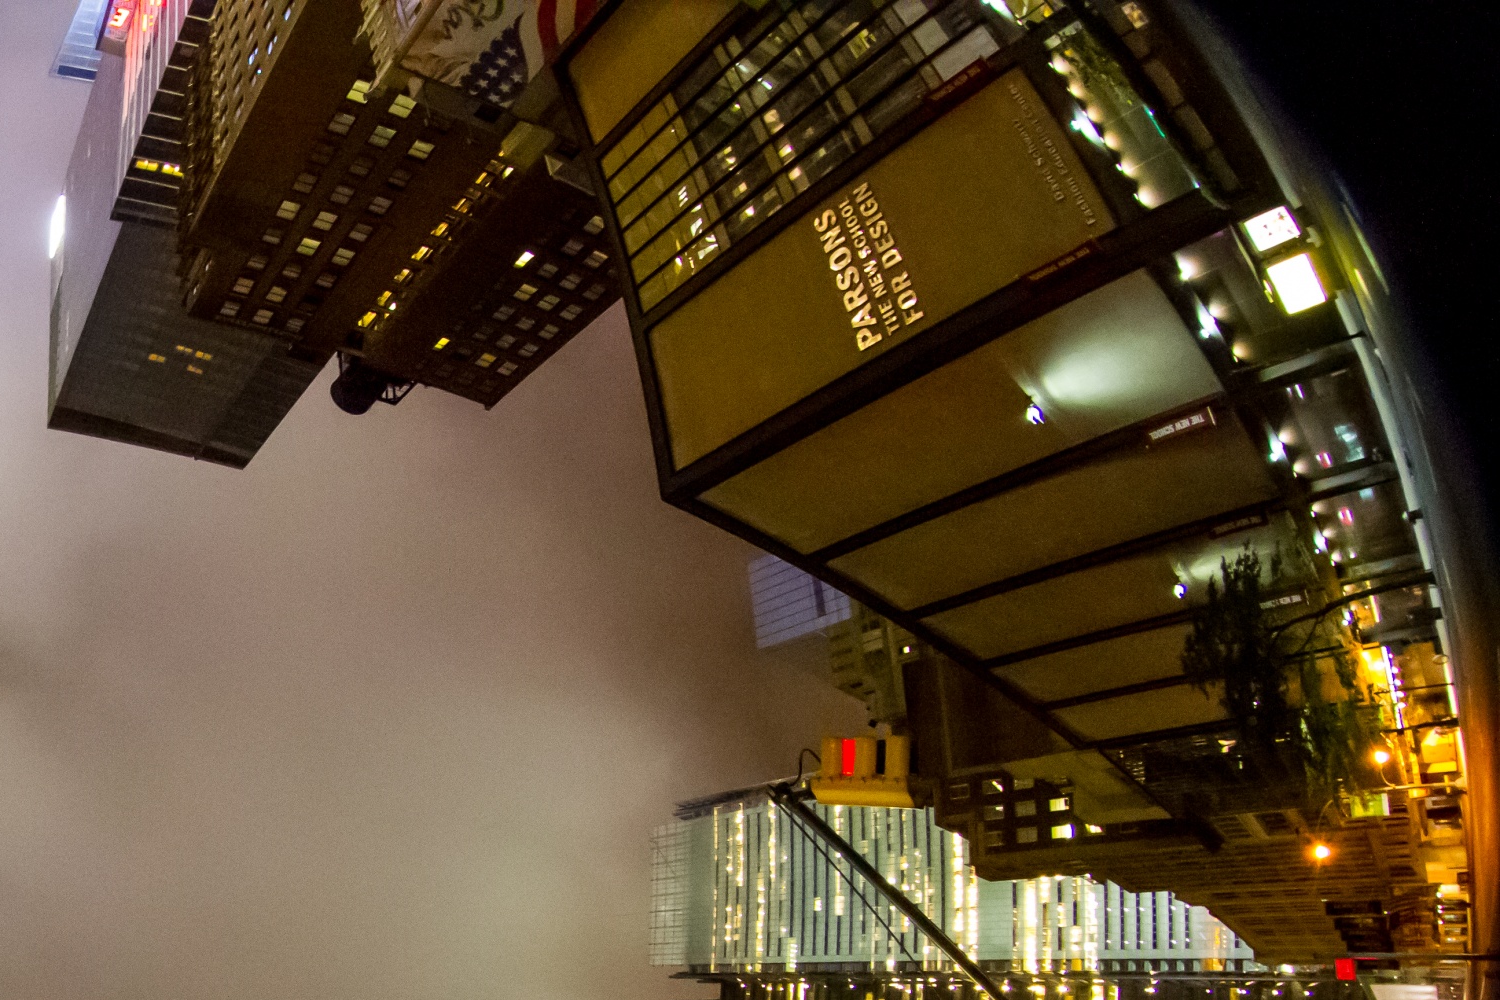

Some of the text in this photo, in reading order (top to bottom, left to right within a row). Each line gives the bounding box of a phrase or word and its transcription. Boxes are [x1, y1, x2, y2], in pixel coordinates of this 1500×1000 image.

[813, 208, 882, 351] PARSONS
[838, 197, 900, 336] THE NEW SCHOOL
[852, 182, 924, 325] FOR DESIGN
